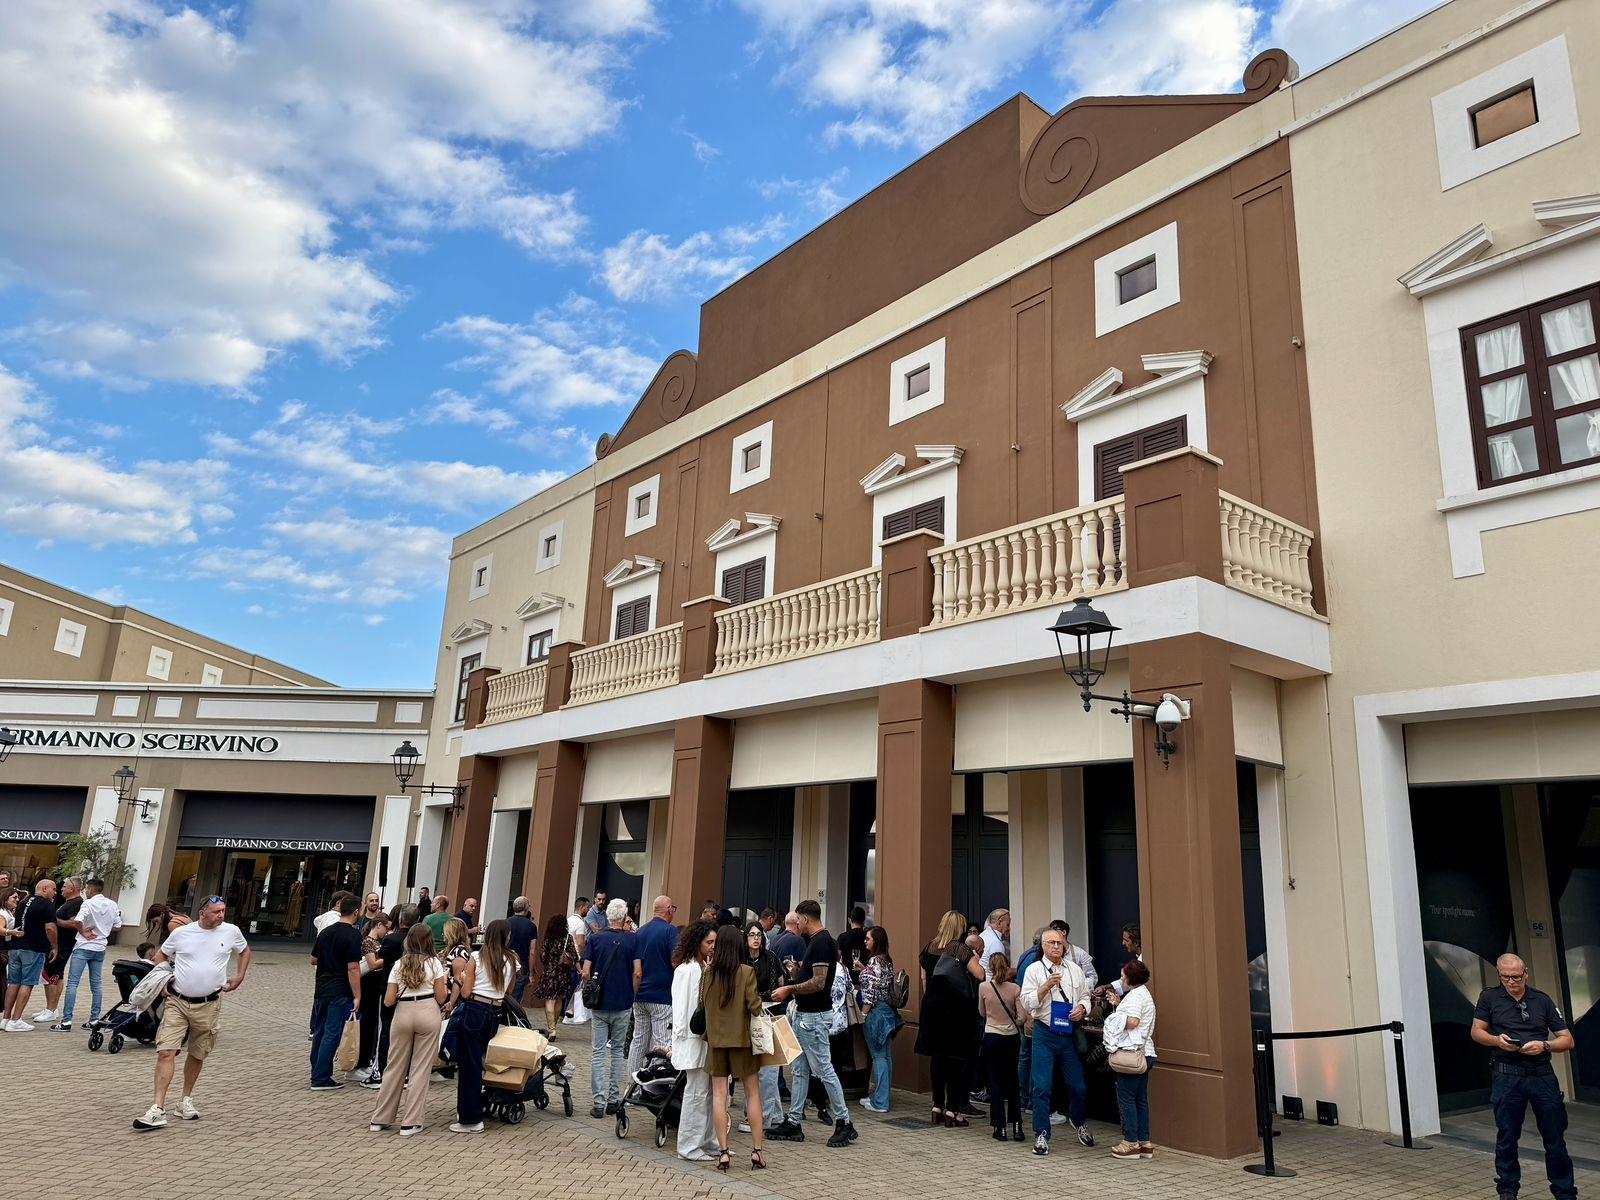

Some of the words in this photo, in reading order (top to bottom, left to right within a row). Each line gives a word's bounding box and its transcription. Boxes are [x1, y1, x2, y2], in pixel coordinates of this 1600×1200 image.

[141, 733, 279, 753] SCERVINO
[0, 830, 60, 841] SCERVINO
[215, 838, 278, 849] ERMANNO
[281, 840, 345, 851] SCERVINO
[1532, 922, 1545, 931] 66
